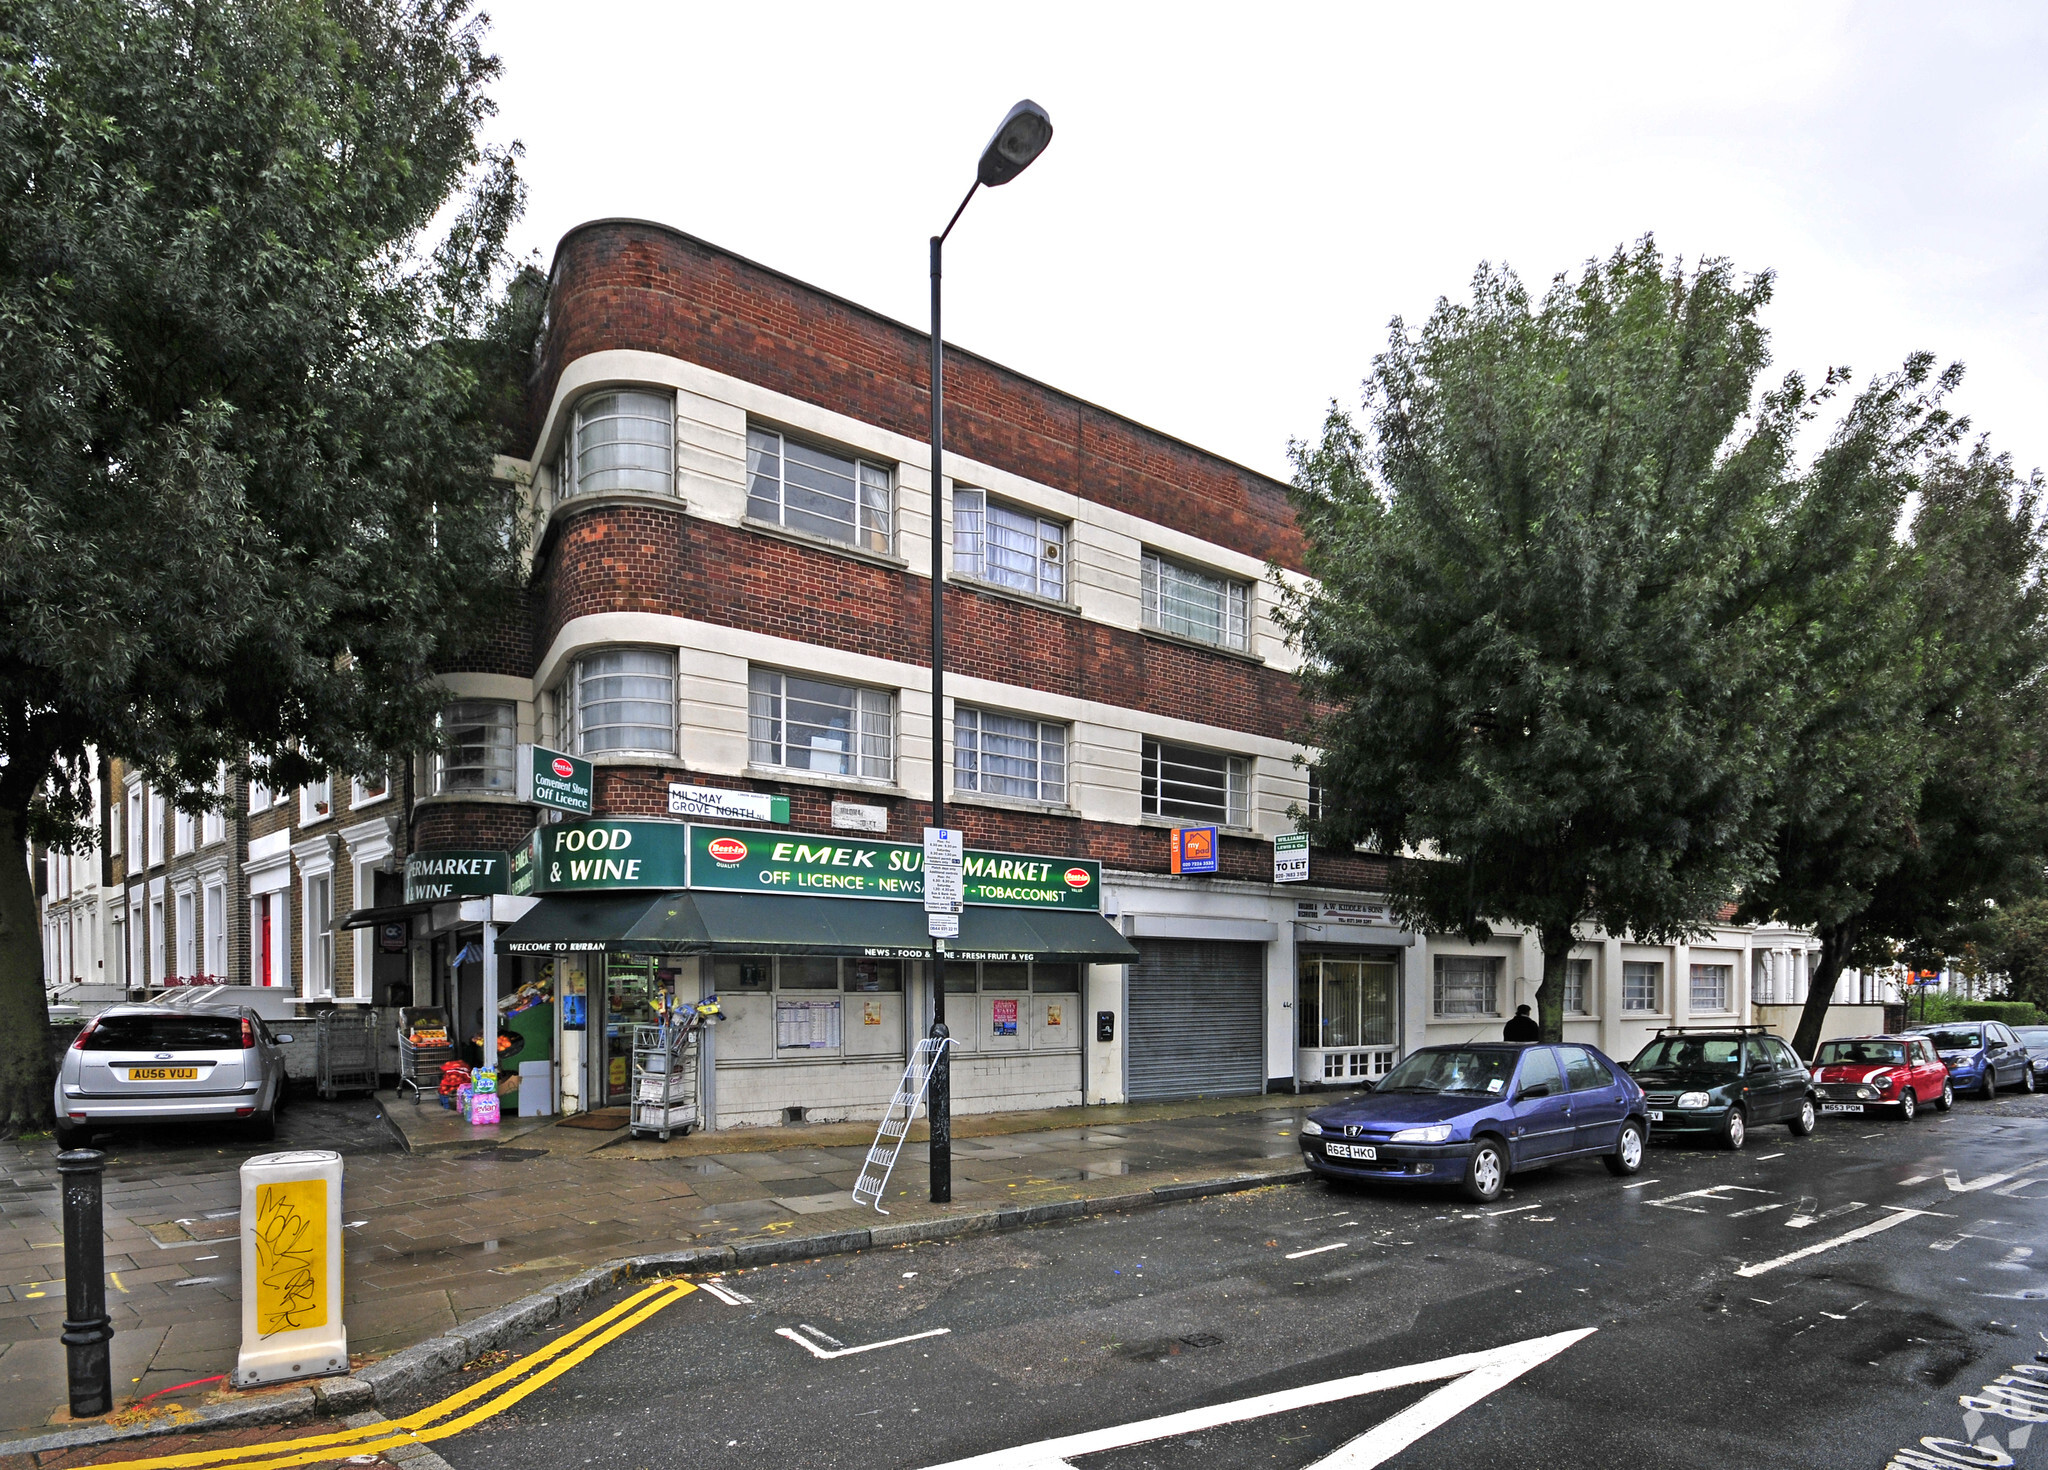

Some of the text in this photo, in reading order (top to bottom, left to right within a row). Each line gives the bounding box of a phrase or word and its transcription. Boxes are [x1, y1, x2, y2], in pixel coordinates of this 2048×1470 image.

[535, 773, 588, 797] Convenient Store
[536, 787, 588, 808] Off Licence
[672, 801, 754, 819] GROVE NORTH
[555, 828, 632, 852] FOOD
[1188, 842, 1199, 850] my
[712, 844, 744, 854] Best-in
[771, 843, 878, 868] EMEK
[550, 861, 562, 883] &
[570, 859, 642, 881] WINE
[1276, 861, 1306, 871] TO LET
[759, 870, 791, 885] OFF
[798, 872, 864, 890] LICENCE
[978, 886, 1066, 903] TOBACCONIST
[1367, 906, 1383, 914] SONS
[509, 942, 606, 951] WELCOME TO KURBAN
[864, 948, 890, 957] NEWS
[897, 950, 922, 958] FOOD
[961, 952, 986, 960] FRESH
[987, 953, 1009, 961] FRUIT
[134, 1069, 193, 1078] AU56 VUJ
[477, 1104, 496, 1112] evian
[1353, 1147, 1375, 1158] HKO
